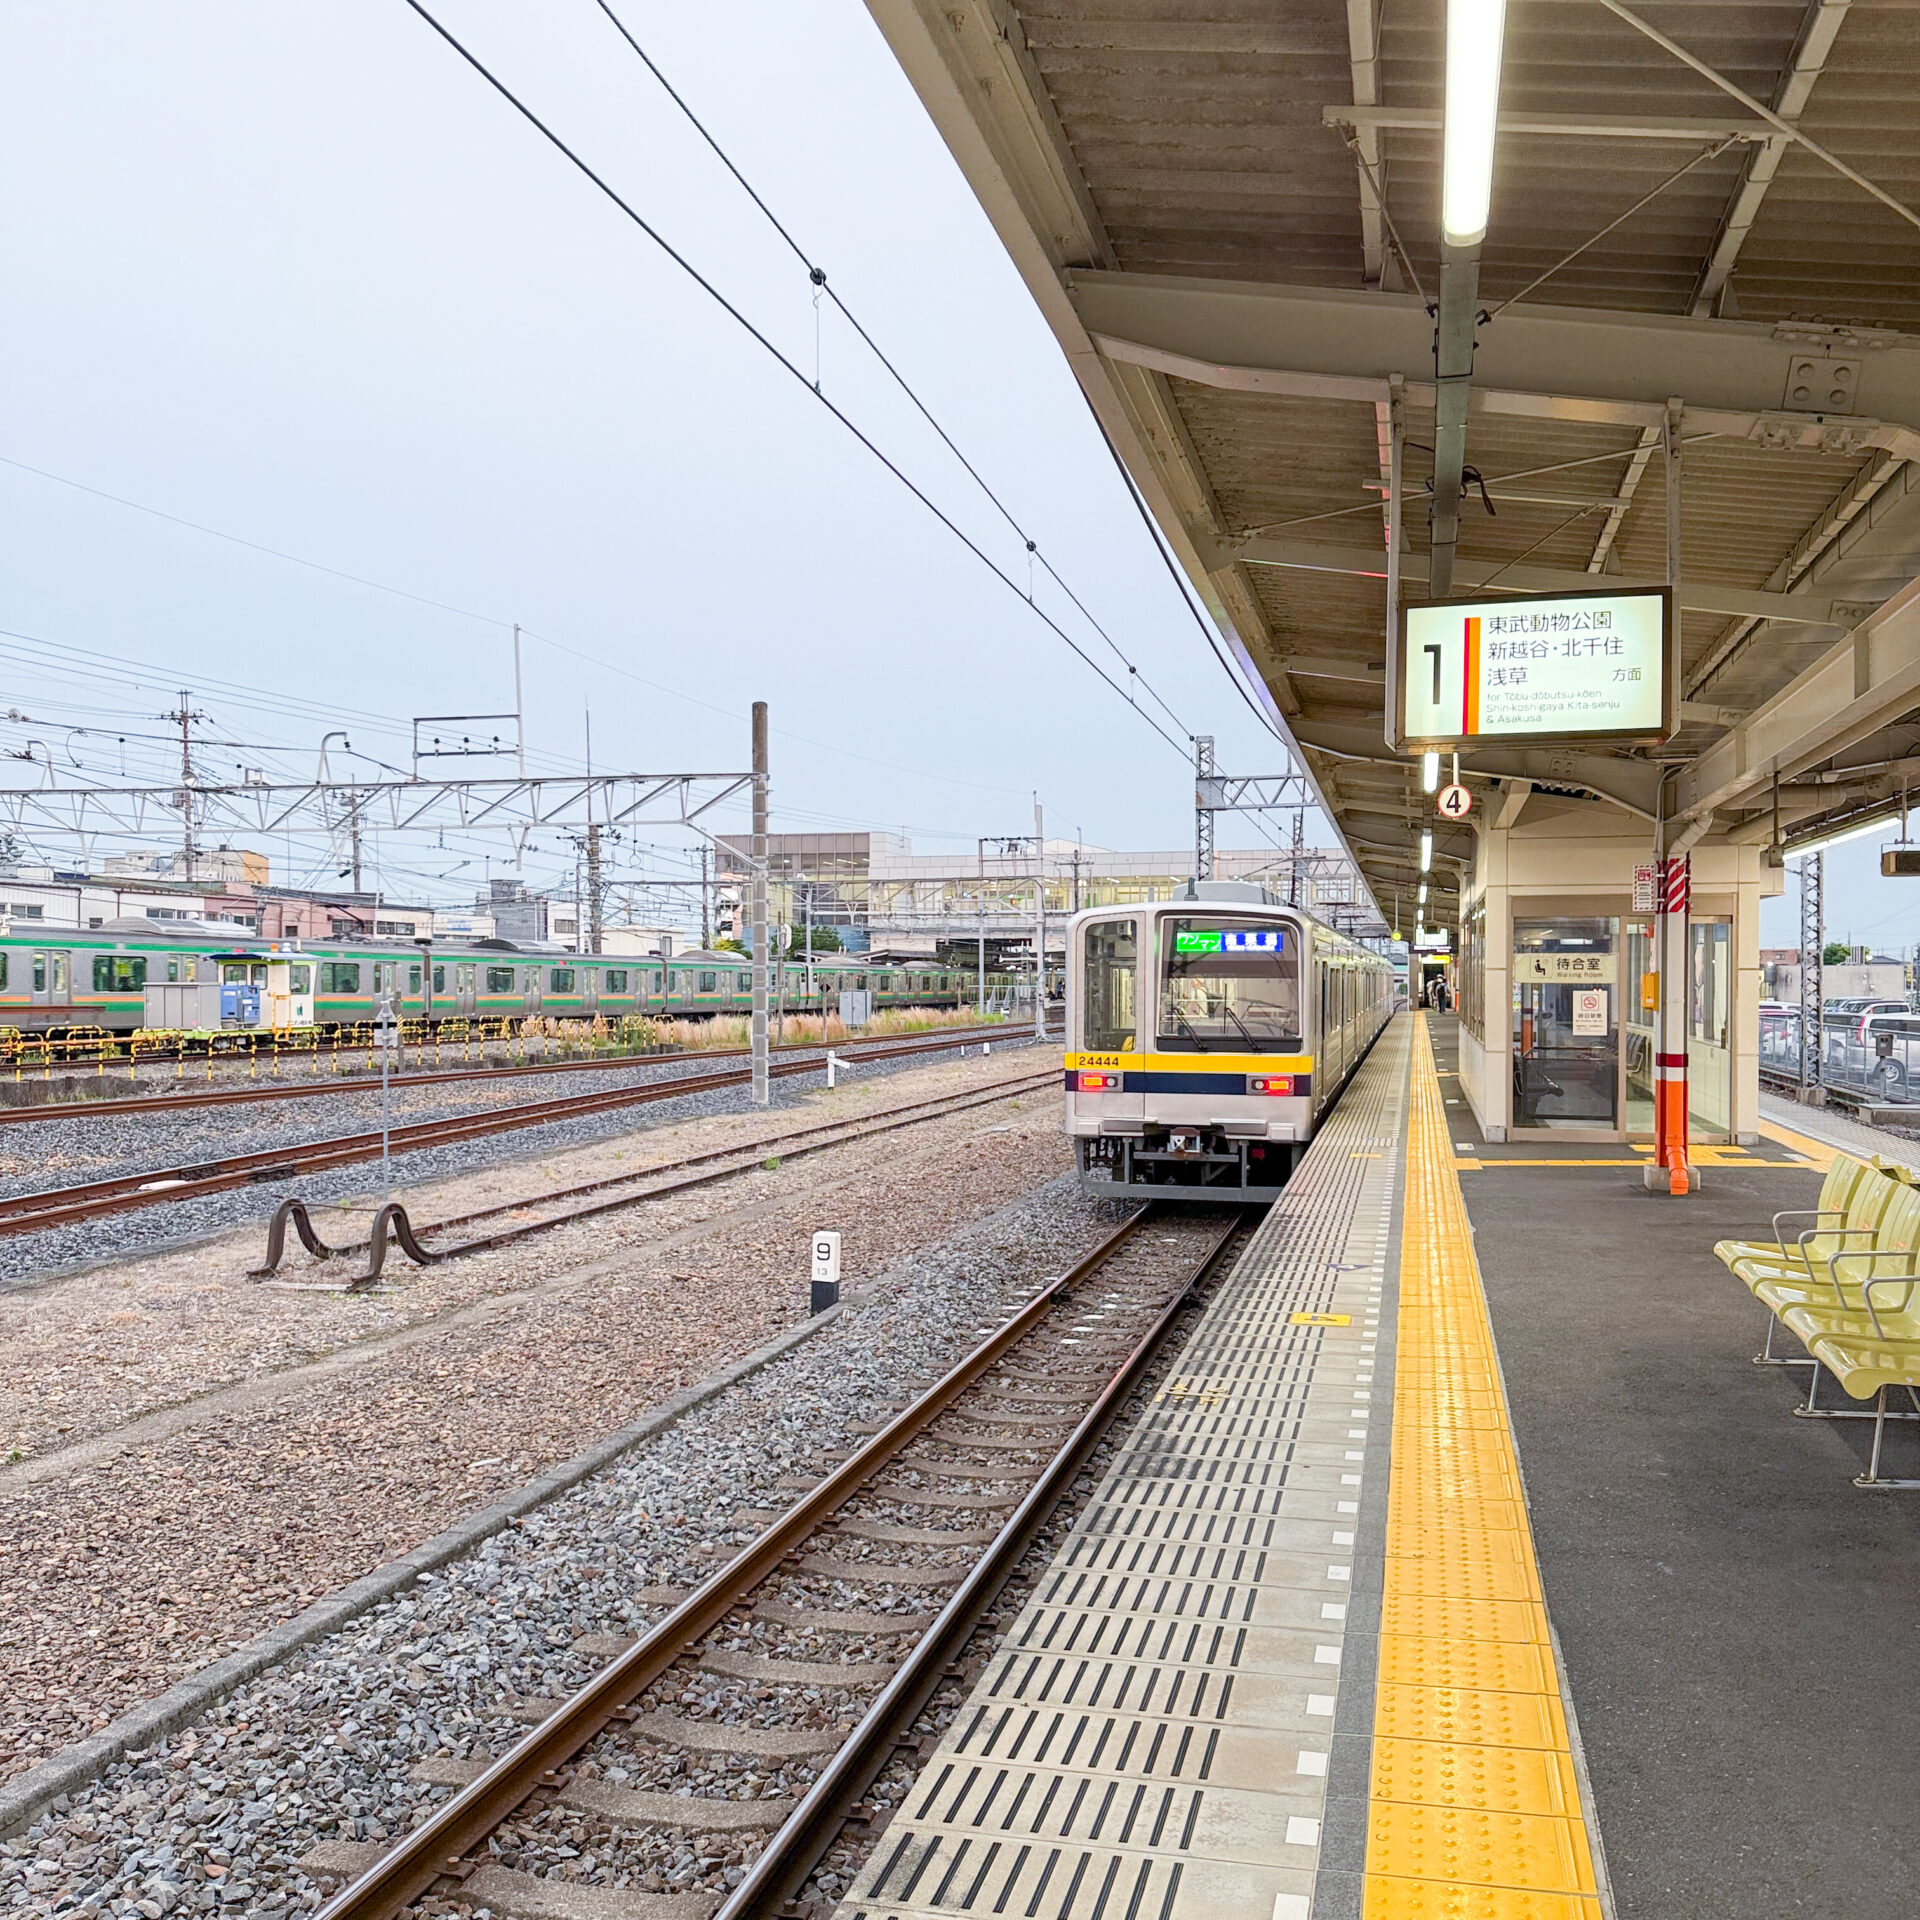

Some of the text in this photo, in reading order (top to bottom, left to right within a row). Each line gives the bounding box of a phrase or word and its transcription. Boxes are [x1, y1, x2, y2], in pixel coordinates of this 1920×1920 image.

[1488, 611, 1612, 634] 東武動物公園
[1423, 644, 1442, 705] 1
[1487, 667, 1642, 686] 浅草 方面
[1487, 692, 1501, 702] for
[1567, 700, 1620, 711] Kita-senju
[1486, 714, 1542, 724] & Asakusa
[1446, 789, 1461, 814] 4
[1178, 933, 1221, 949] ワンマン
[1557, 958, 1601, 970] 待合室
[1078, 1056, 1120, 1066] 24444
[816, 1242, 831, 1261] 9
[816, 1267, 828, 1276] 13
